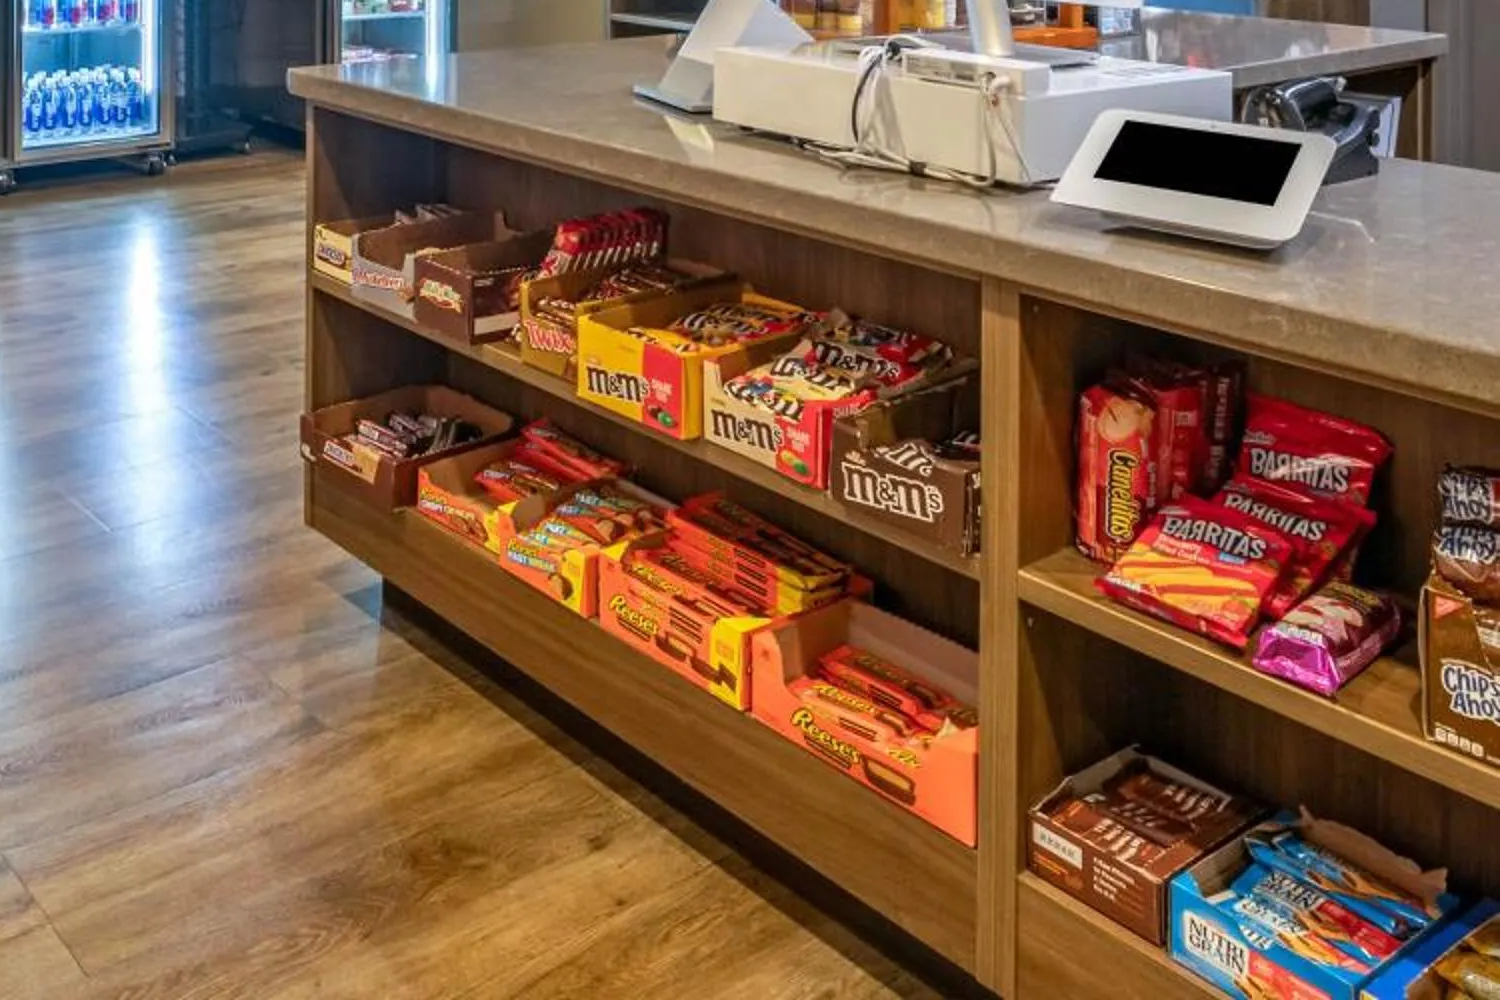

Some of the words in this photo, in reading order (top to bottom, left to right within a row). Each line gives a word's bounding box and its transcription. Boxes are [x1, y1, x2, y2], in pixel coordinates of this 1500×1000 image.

[1109, 451, 1140, 538] Canelitas
[1162, 516, 1267, 559] BARRITAS
[1189, 917, 1245, 959] NUTRI
[1189, 935, 1245, 976] GRAIN
